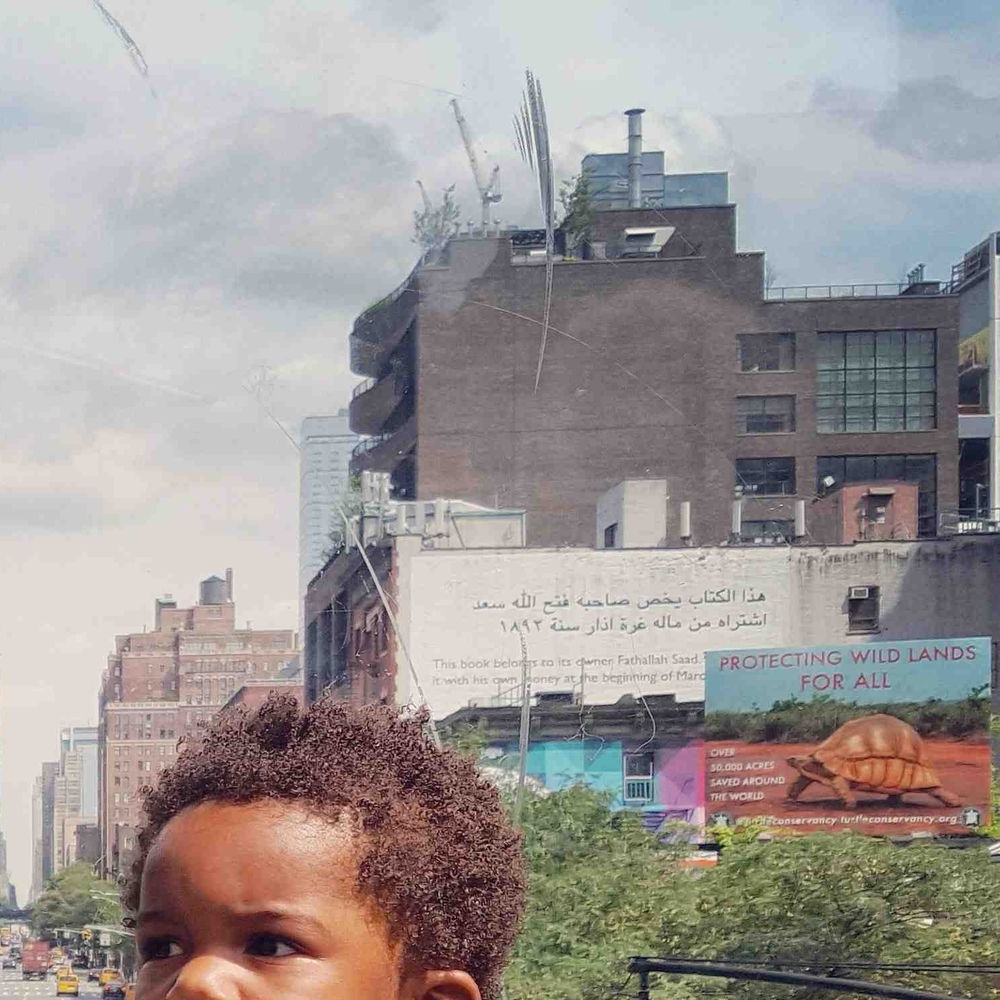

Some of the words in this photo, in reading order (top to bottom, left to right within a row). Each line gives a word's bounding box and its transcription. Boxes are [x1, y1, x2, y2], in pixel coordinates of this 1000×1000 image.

[637, 592, 682, 609] يخص
[688, 588, 736, 609] الكتاب
[742, 588, 766, 603] هذا
[473, 600, 505, 610] سعد
[543, 594, 569, 614] فتح
[550, 617, 580, 631] سنة
[653, 614, 681, 628] ماله
[689, 617, 711, 632] من
[718, 613, 767, 631] اشتراه
[432, 658, 457, 669] This
[460, 659, 490, 669] book
[540, 659, 554, 668] to
[558, 657, 572, 668] its
[618, 654, 668, 666] Fathallah
[672, 653, 701, 665] Saad.
[720, 651, 843, 671] PROTECTING
[851, 648, 900, 665] WILD
[908, 645, 977, 663] LANDS
[445, 676, 469, 686] with
[473, 675, 488, 685] his
[493, 677, 517, 685] own
[522, 676, 560, 686] oney
[602, 672, 657, 684] beginning
[661, 671, 673, 681] of
[676, 671, 706, 681] Marc
[801, 674, 845, 691] FOR
[853, 672, 892, 689] ALL
[710, 748, 735, 757] OVER
[745, 760, 775, 770] ACRES
[711, 777, 740, 787] SAVED
[743, 776, 785, 786] AROUND
[711, 792, 728, 801] THE
[729, 791, 765, 801] WORLD
